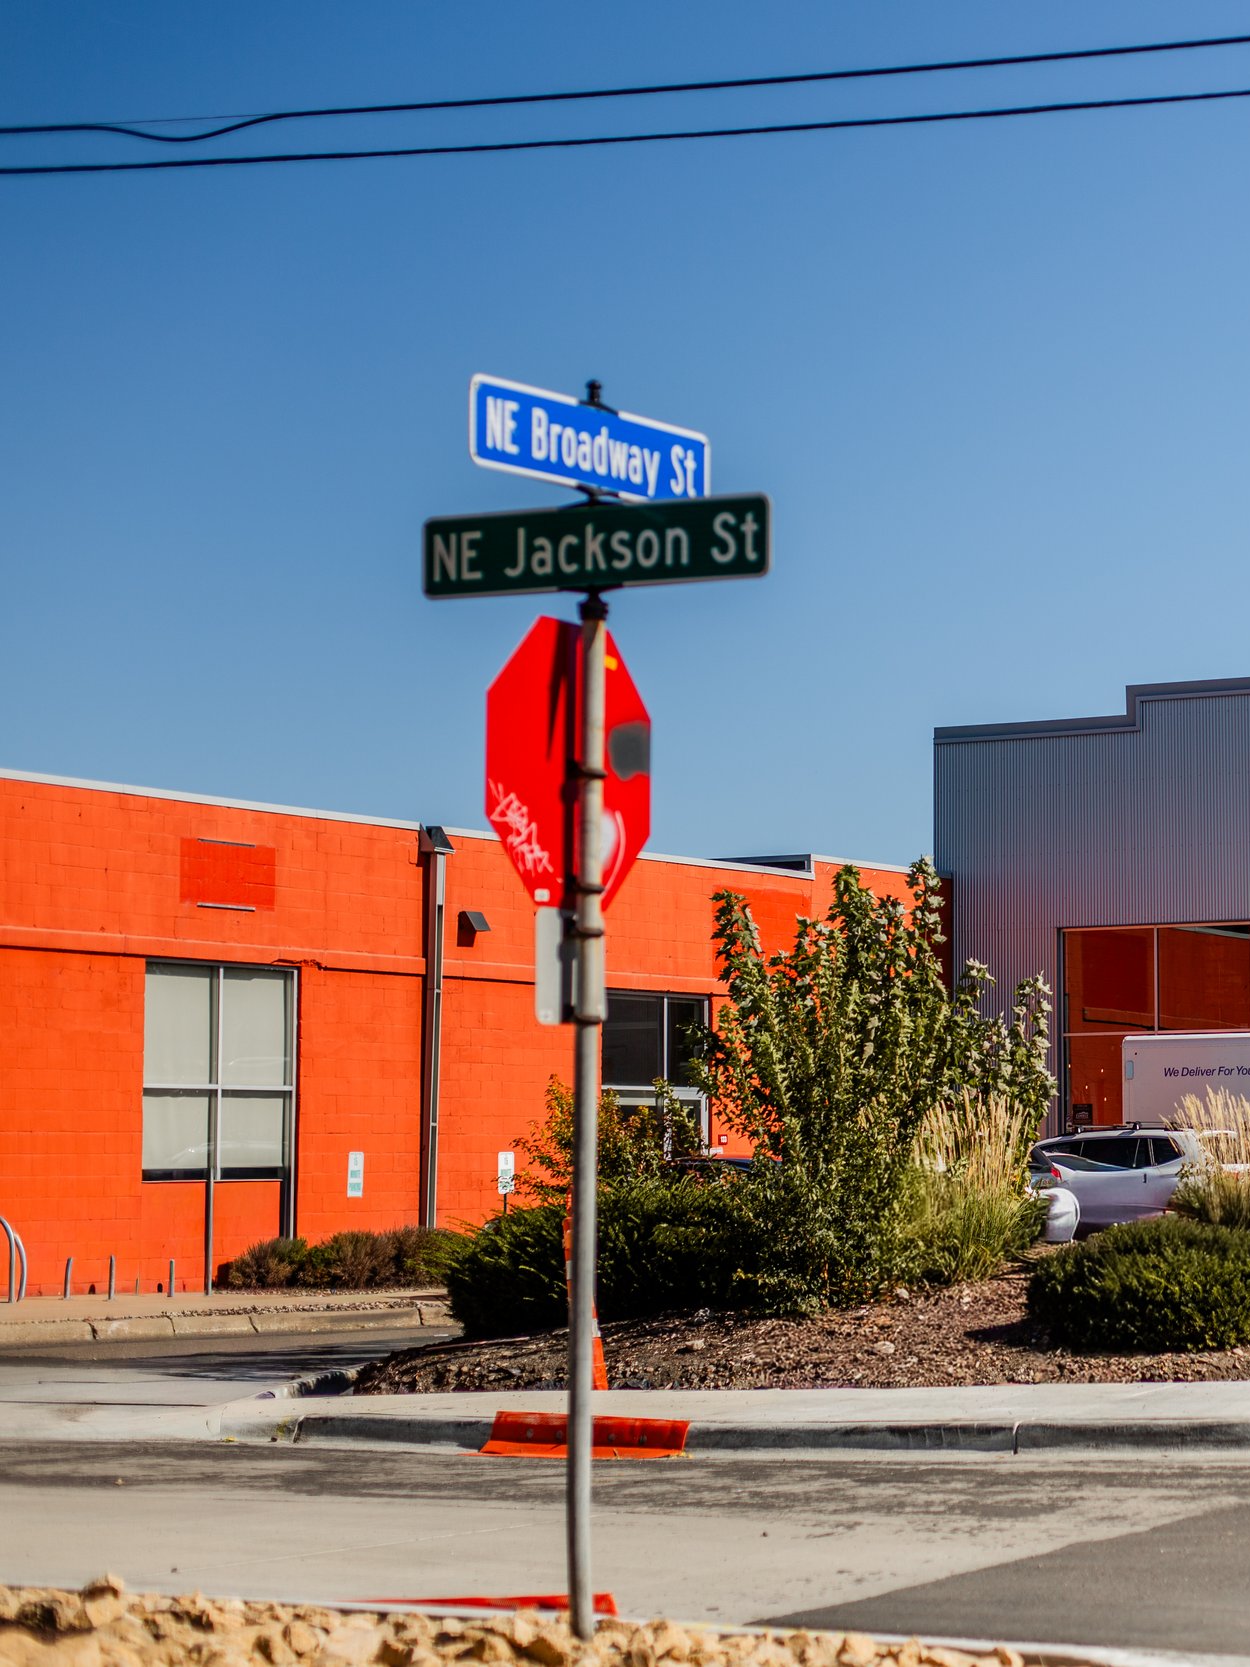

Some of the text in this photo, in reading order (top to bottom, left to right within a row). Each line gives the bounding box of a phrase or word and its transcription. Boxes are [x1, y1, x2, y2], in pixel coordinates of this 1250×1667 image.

[485, 396, 697, 498] NE Broadway St
[432, 512, 758, 582] NE Jackson St
[1164, 1067, 1179, 1077] We
[1181, 1066, 1216, 1077] Deliver
[1218, 1066, 1234, 1076] For
